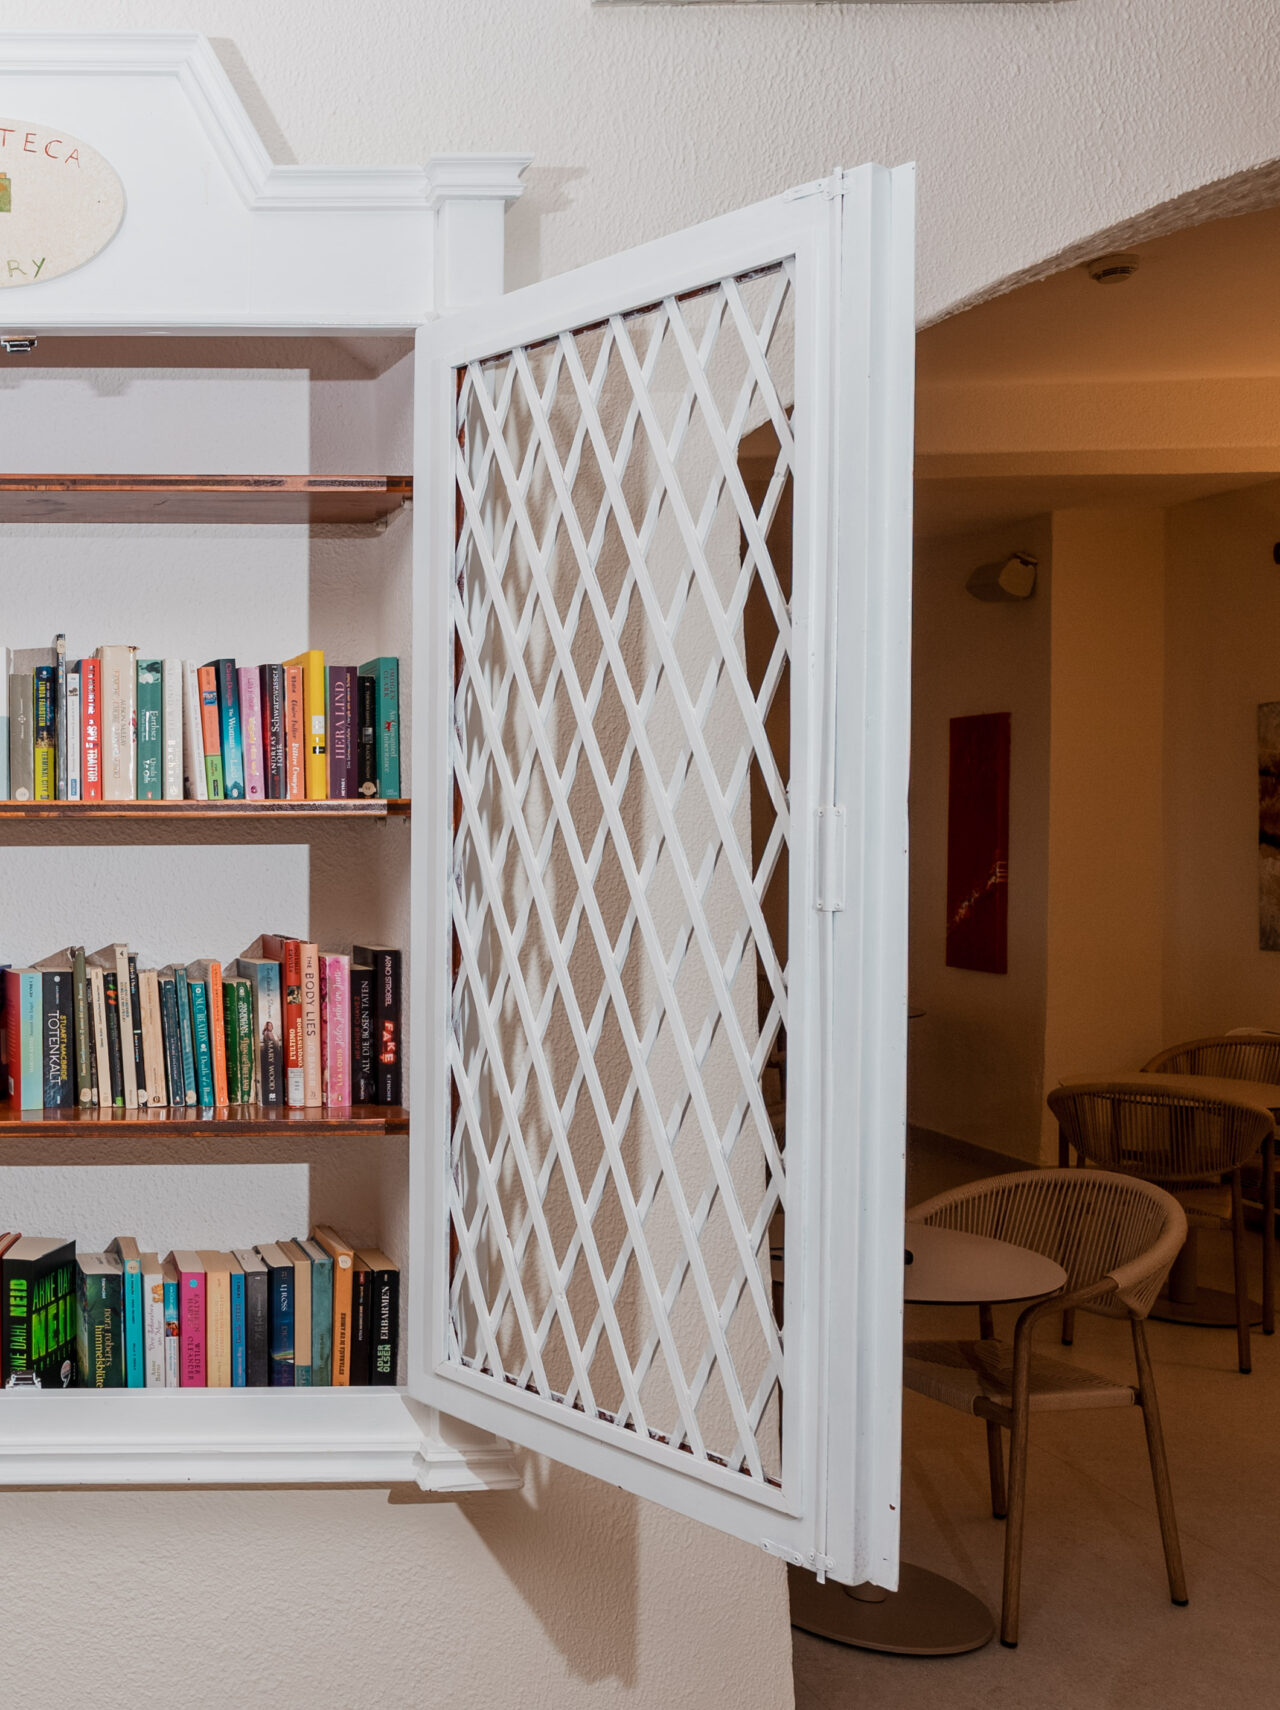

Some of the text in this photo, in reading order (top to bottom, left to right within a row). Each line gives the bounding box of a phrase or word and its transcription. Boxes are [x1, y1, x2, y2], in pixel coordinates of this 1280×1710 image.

[270, 670, 280, 733] Schwarzwasser
[87, 725, 99, 741] SPY
[150, 711, 160, 741] Earthsea
[228, 717, 236, 748] Woman
[334, 681, 346, 759] HERA LIND
[41, 750, 49, 792] TERMINAL CITY
[87, 750, 99, 782] TRAITOR
[167, 739, 177, 783] Buchan
[305, 972, 316, 1007] BODY
[360, 980, 370, 1007] TATEN
[385, 955, 393, 1007] ARNO STROBEL
[196, 1013, 208, 1042] BEATON
[306, 1011, 317, 1037] LIES
[360, 1011, 370, 1039] BÖSEN
[48, 1010, 61, 1086] TOTENKALT
[289, 1028, 297, 1060] L'ULTIMO
[361, 1040, 370, 1056] DIE
[382, 1022, 396, 1063] FAKE
[60, 1044, 68, 1081] MACBRIDE
[267, 1040, 276, 1090] MARY WOOD
[308, 1056, 317, 1086] BAKER
[361, 1059, 370, 1073] ALL
[9, 1279, 28, 1317] NEID
[280, 1292, 288, 1312] ROSS
[380, 1286, 390, 1340] ERBARMEN
[9, 1324, 28, 1350] DAHL
[104, 1308, 116, 1367] nora roberts
[94, 1325, 108, 1389] himmelsblüte
[383, 1344, 391, 1373] OLSEN
